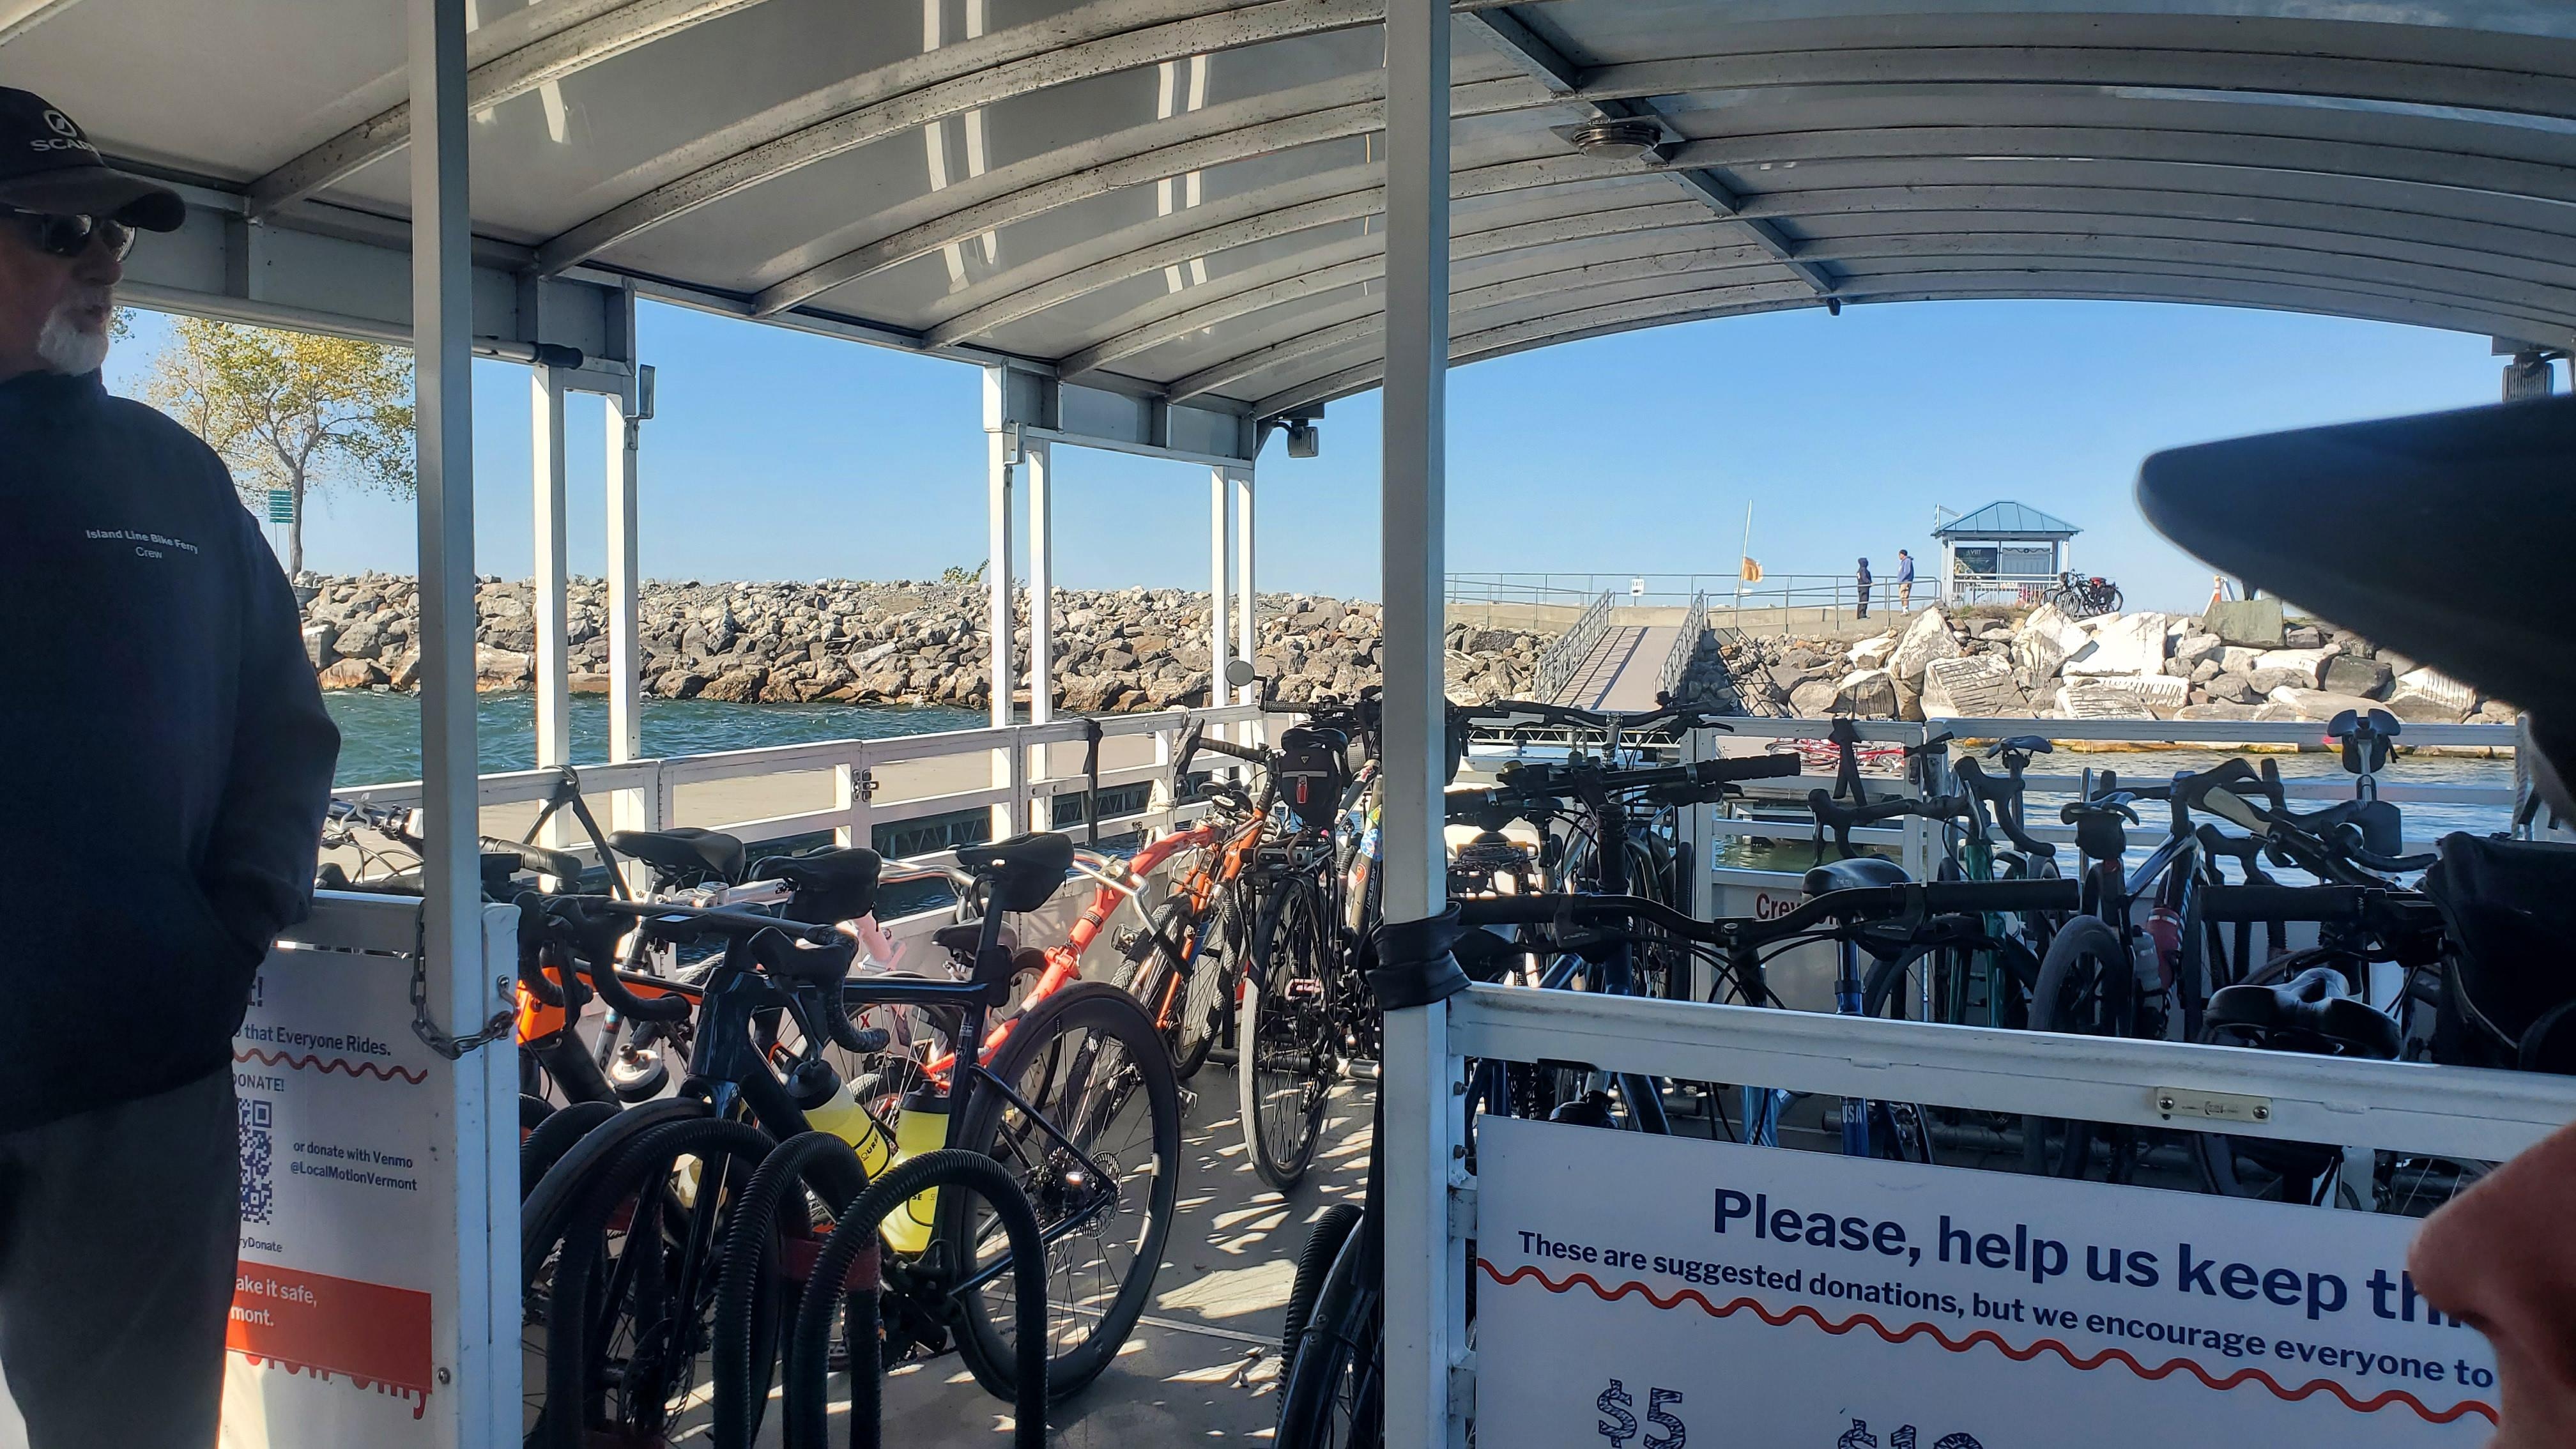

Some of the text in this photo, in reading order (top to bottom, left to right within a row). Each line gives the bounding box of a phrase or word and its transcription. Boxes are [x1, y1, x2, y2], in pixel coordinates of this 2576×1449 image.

[86, 530, 198, 555] Island Line Bike Ferry
[135, 547, 162, 558] Crew
[245, 1023, 392, 1056] that Everyone Rides.
[1842, 1105, 1862, 1124] USA
[293, 1142, 413, 1169] or donate with Venmo
[291, 1161, 418, 1192] @LocalMotionVermont
[1714, 1188, 2461, 1328] Please, help us keep th
[236, 1275, 317, 1308] ake it safe,
[231, 1305, 274, 1326] mont.
[1518, 1230, 2494, 1388] These are suggested donations, but we encourage everyone to
[1597, 1378, 1685, 1449] $5
